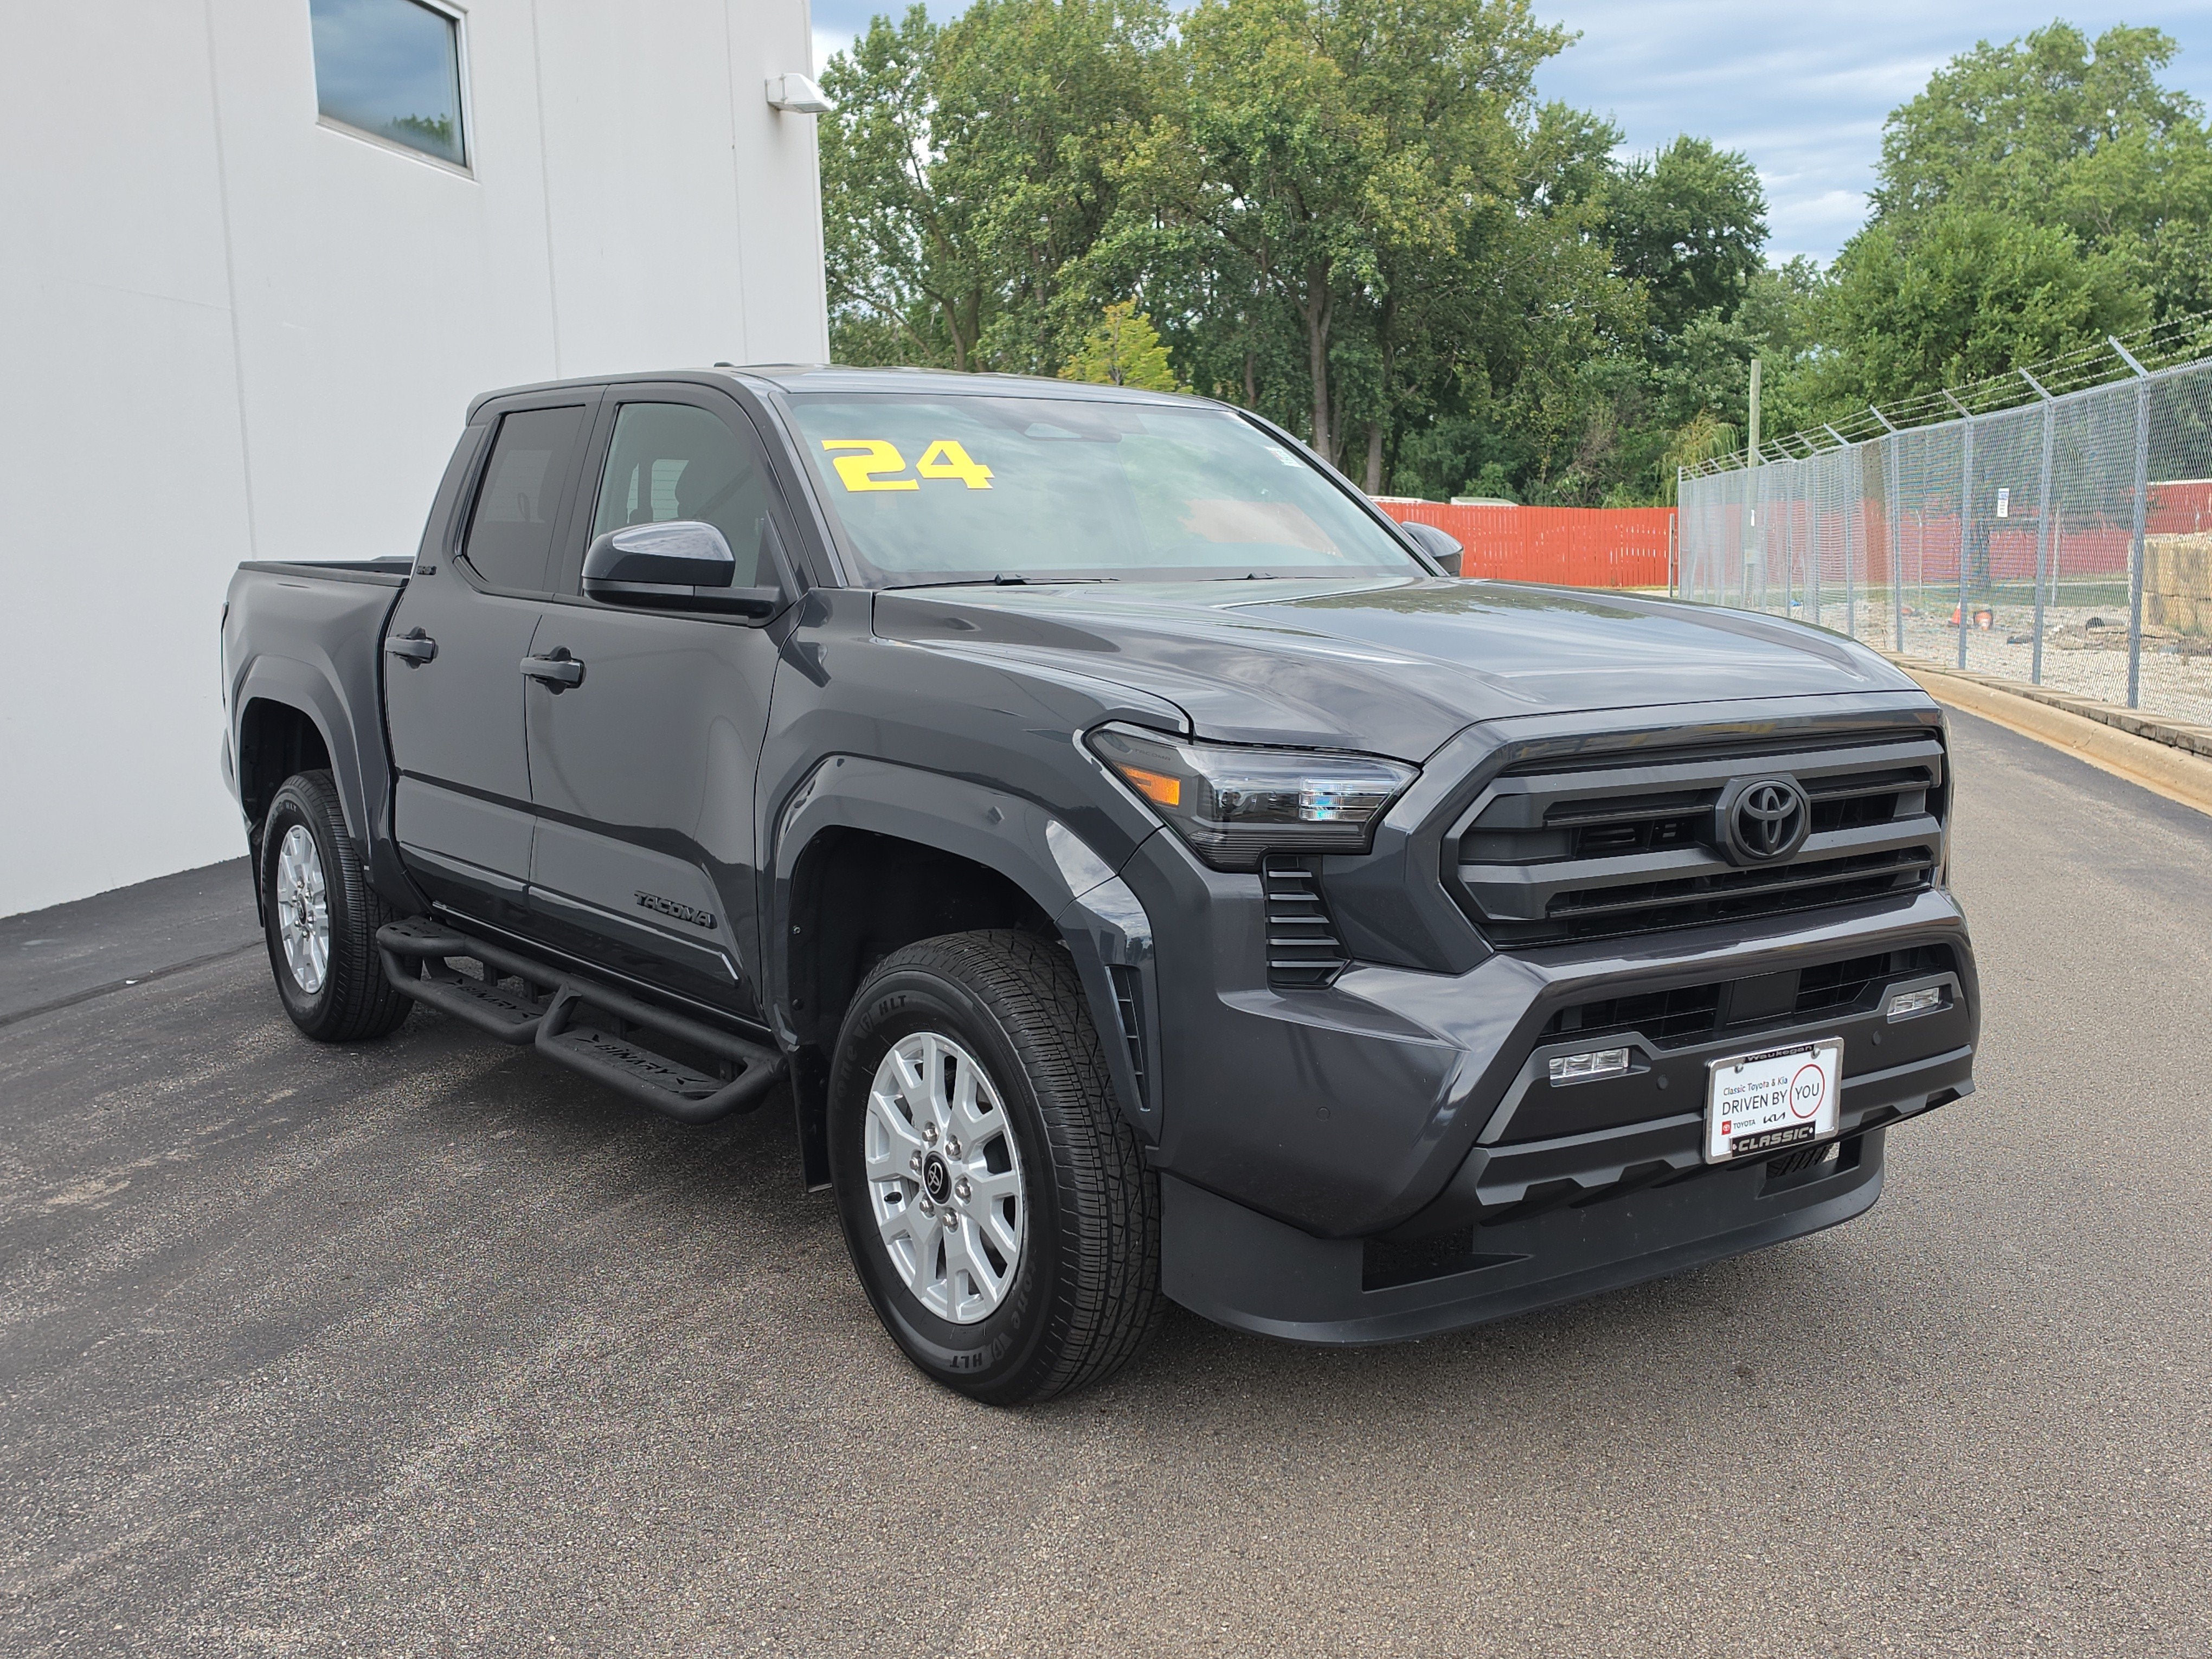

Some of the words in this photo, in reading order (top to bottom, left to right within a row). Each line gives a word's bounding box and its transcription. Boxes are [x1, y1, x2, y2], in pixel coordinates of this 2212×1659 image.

[821, 440, 994, 492] 24
[634, 890, 717, 929] TACOMA
[879, 995, 906, 1016] HLT
[1747, 1046, 1812, 1062] Waukegan
[1724, 1085, 1746, 1096] Classic
[1747, 1081, 1770, 1092] Toyota
[1771, 1078, 1776, 1086] &
[1778, 1076, 1788, 1085] Kia
[1722, 1093, 1769, 1115] DRIVEN
[1772, 1089, 1788, 1105] BY
[1795, 1083, 1819, 1101] YOU
[1733, 1120, 1756, 1129] TOYOTA
[1738, 1127, 1810, 1152] CLASSIC
[950, 1352, 982, 1368] HLT
